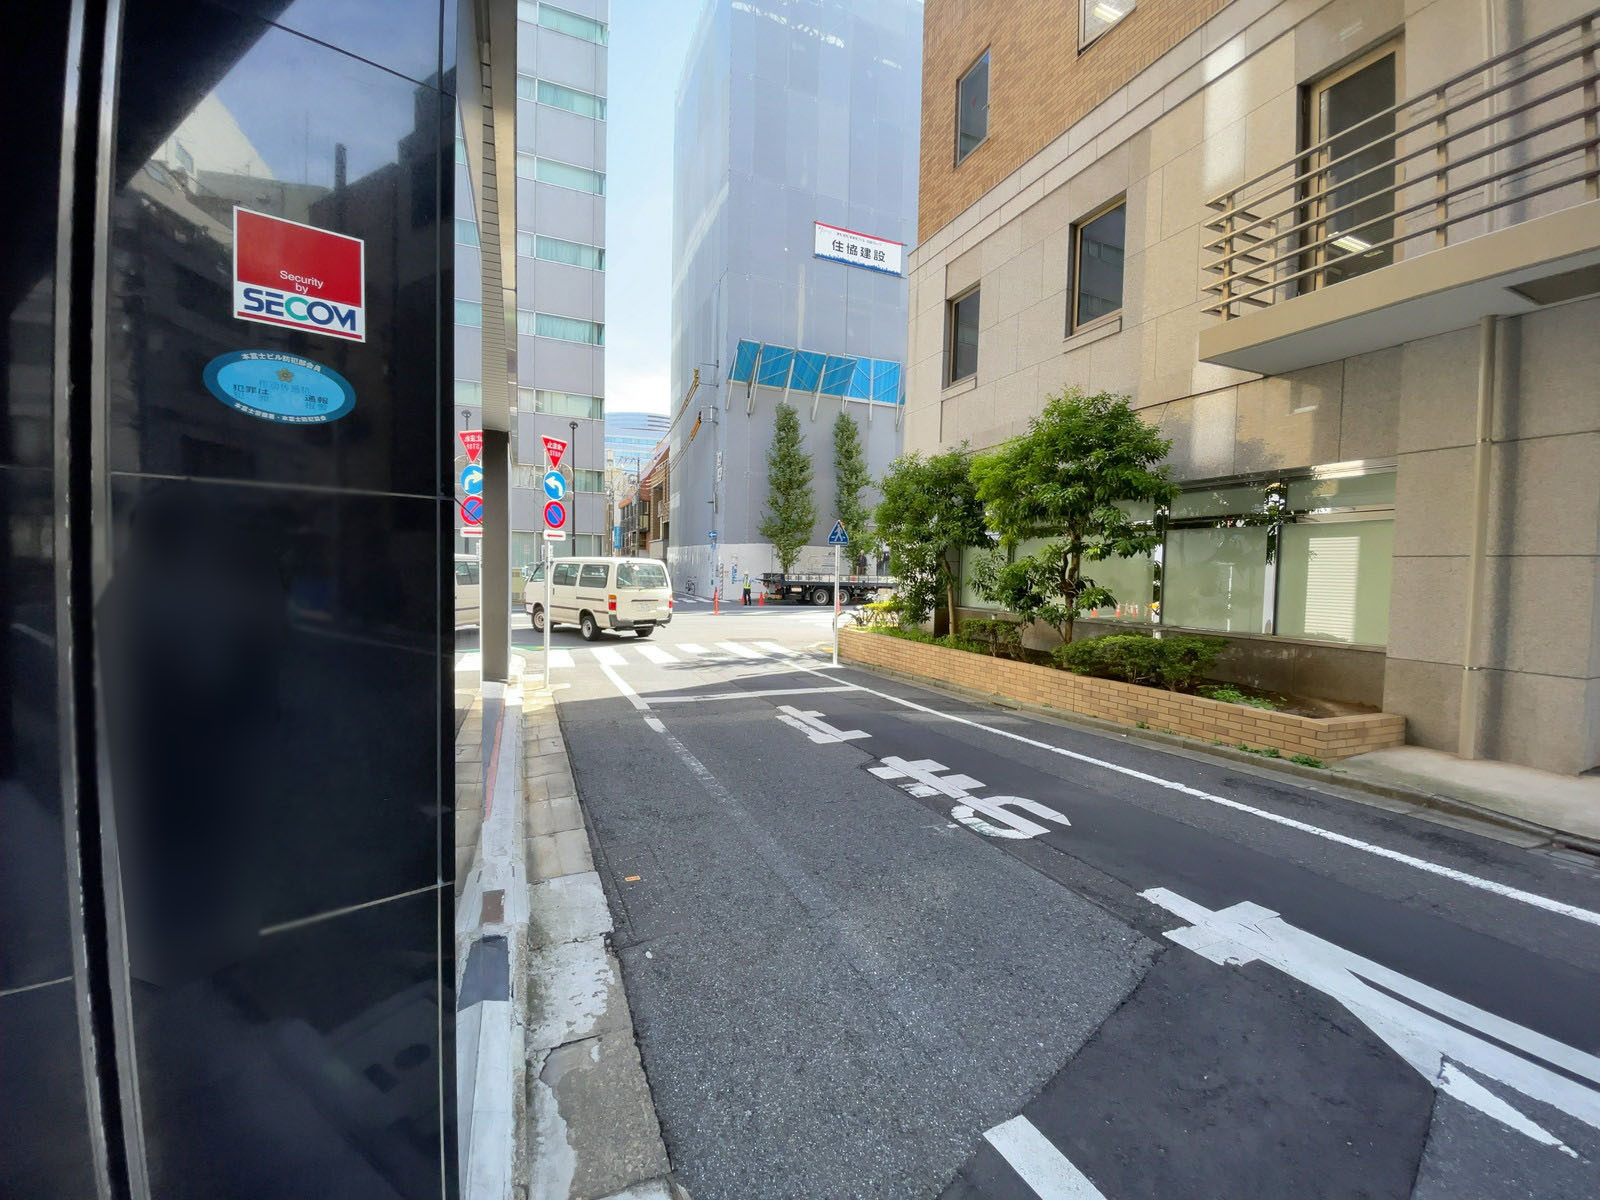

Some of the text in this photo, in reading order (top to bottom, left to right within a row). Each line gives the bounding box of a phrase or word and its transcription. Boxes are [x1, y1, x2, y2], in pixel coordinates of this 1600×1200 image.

[832, 239, 885, 262] 住協建設
[279, 270, 324, 289] Security
[295, 282, 309, 295] by
[243, 287, 356, 331] SECOM
[549, 449, 561, 457] STOP
